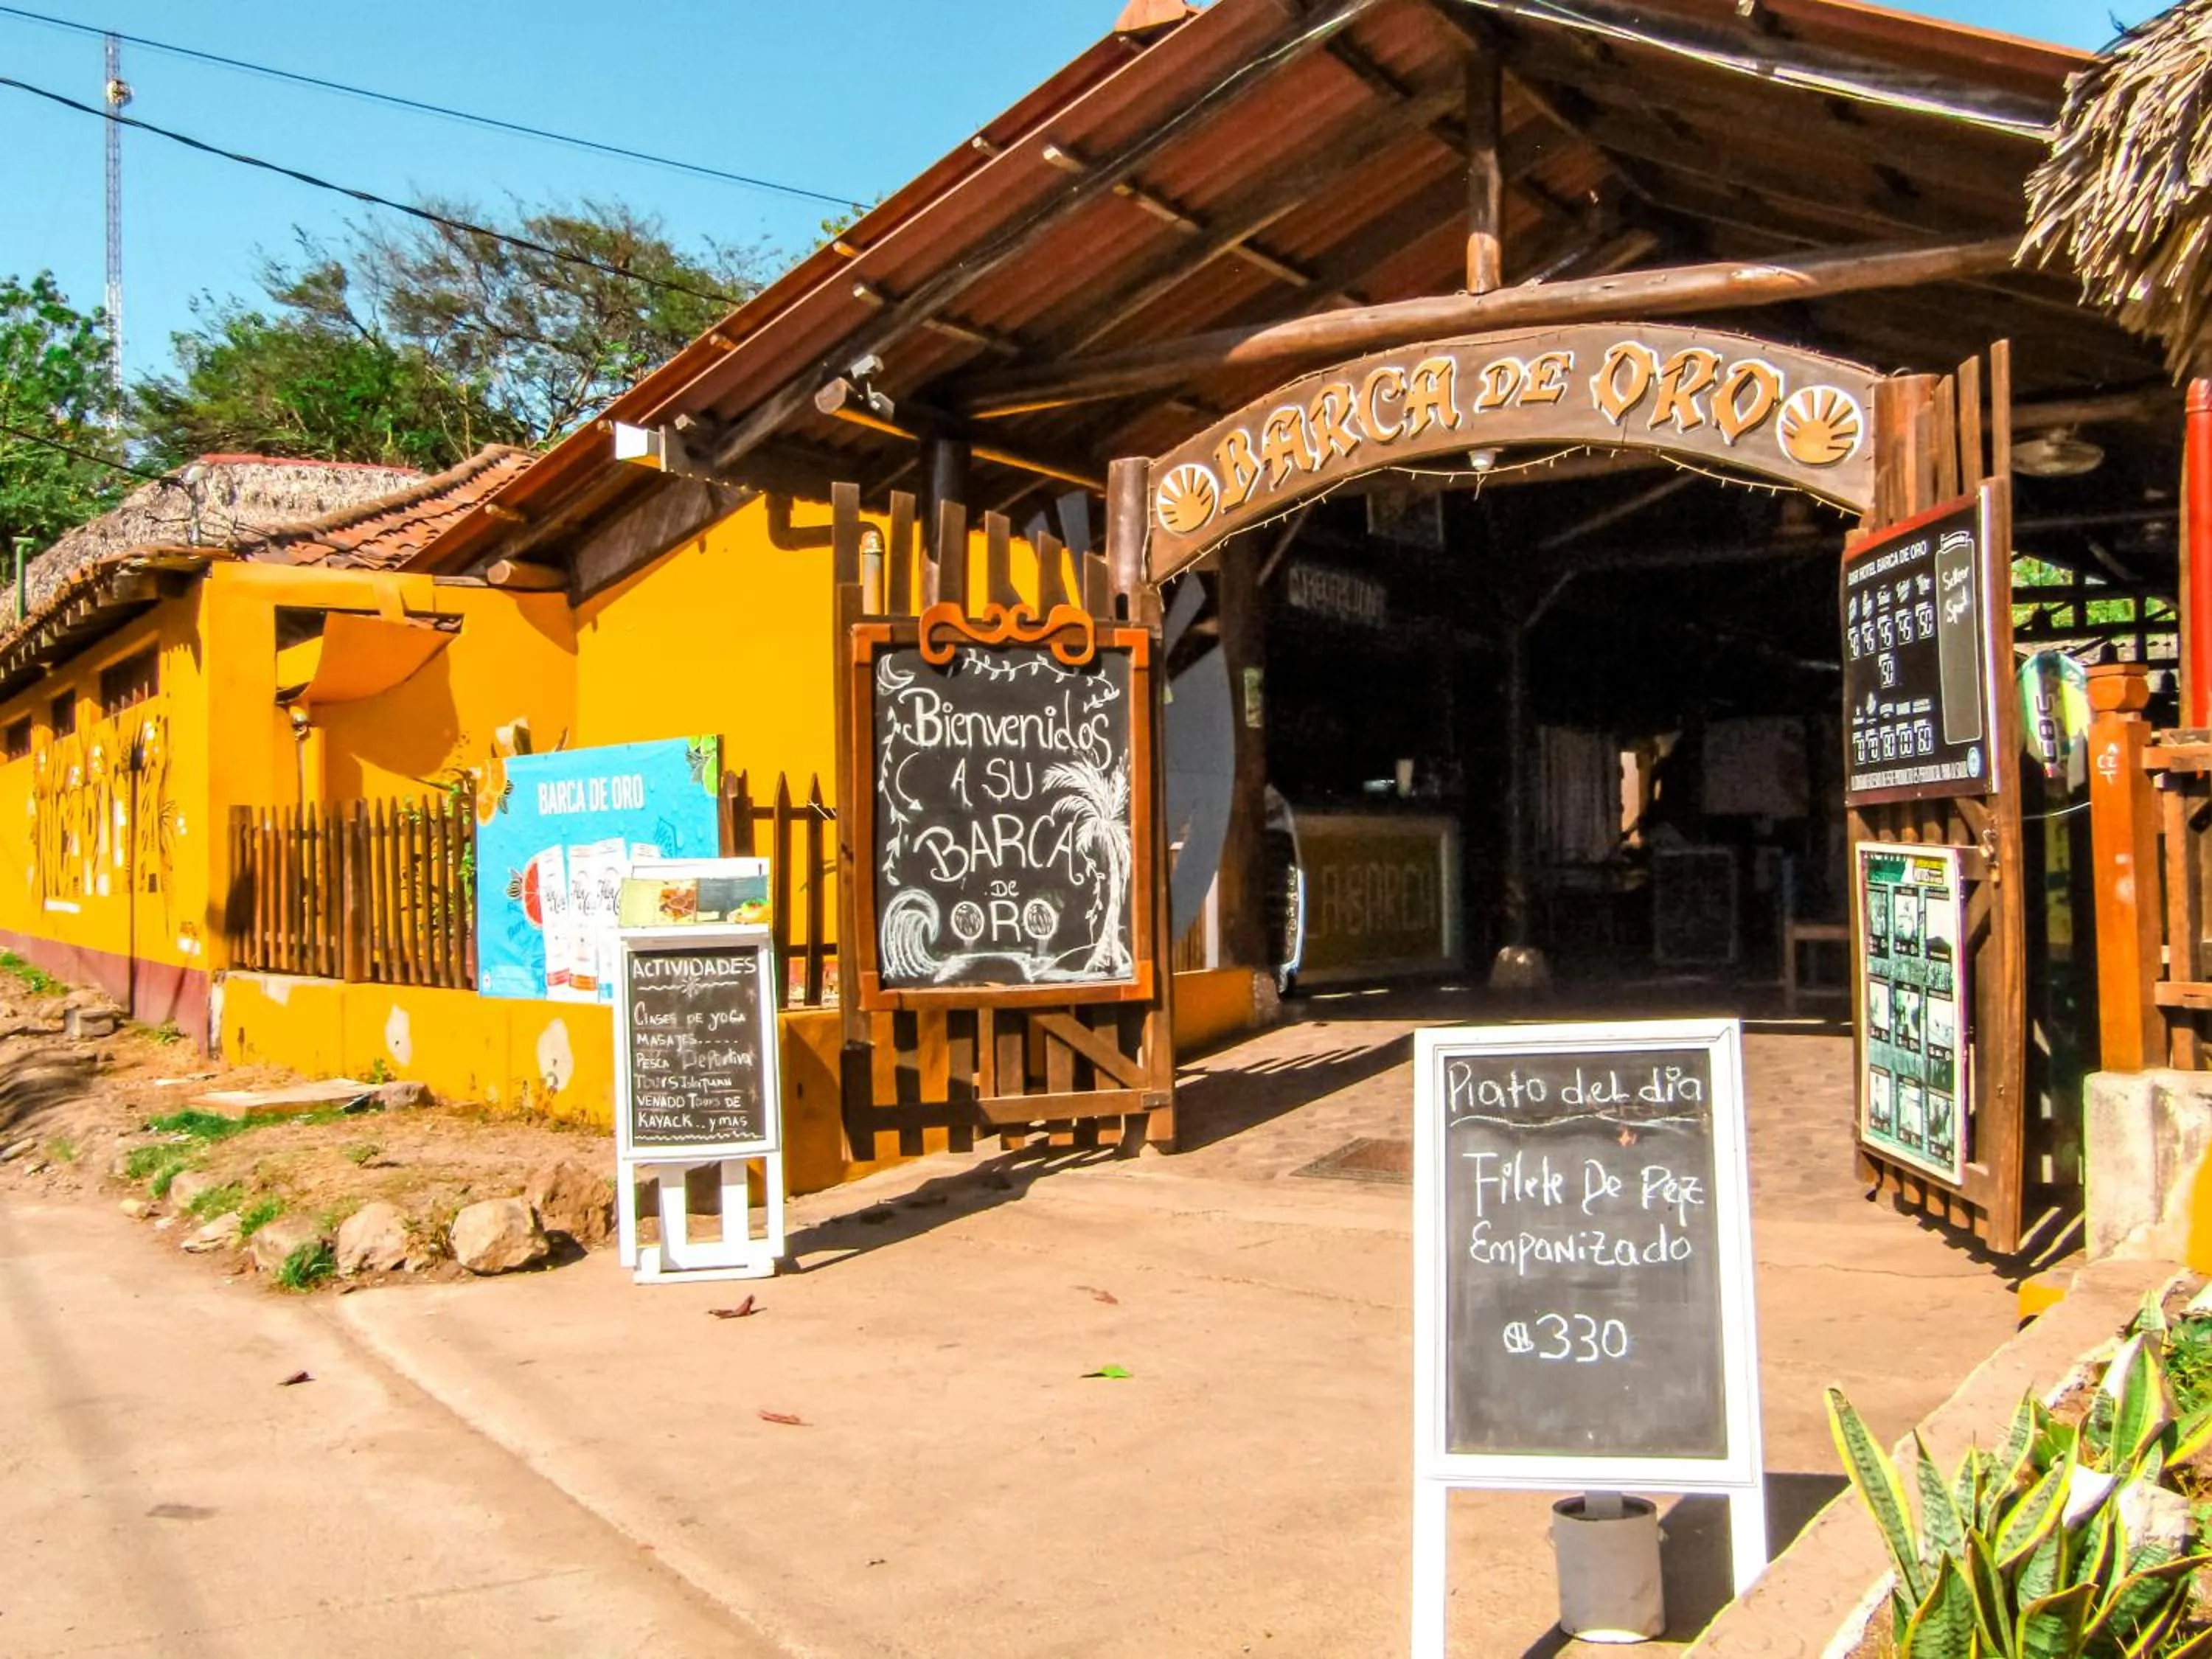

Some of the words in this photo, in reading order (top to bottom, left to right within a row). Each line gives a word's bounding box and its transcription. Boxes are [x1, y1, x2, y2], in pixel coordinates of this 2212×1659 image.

[1214, 355, 1461, 513] BARCA
[1475, 352, 1574, 413] DE
[1590, 341, 1784, 446] ORO
[1910, 540, 1927, 559] ORO
[898, 686, 1111, 770] Bienvenidos
[538, 779, 586, 815] BARCA
[589, 777, 609, 811] DE
[612, 774, 644, 810] ORO
[950, 759, 972, 807] A
[983, 759, 1033, 801] SU
[914, 814, 1084, 885] BARCA
[951, 899, 1057, 942] ORO
[633, 958, 757, 978] ACTIVIDADES
[687, 1012, 704, 1024] DE
[636, 1095, 685, 1108] VENADO
[725, 1096, 742, 1107] DE
[1582, 1158, 1622, 1216] De
